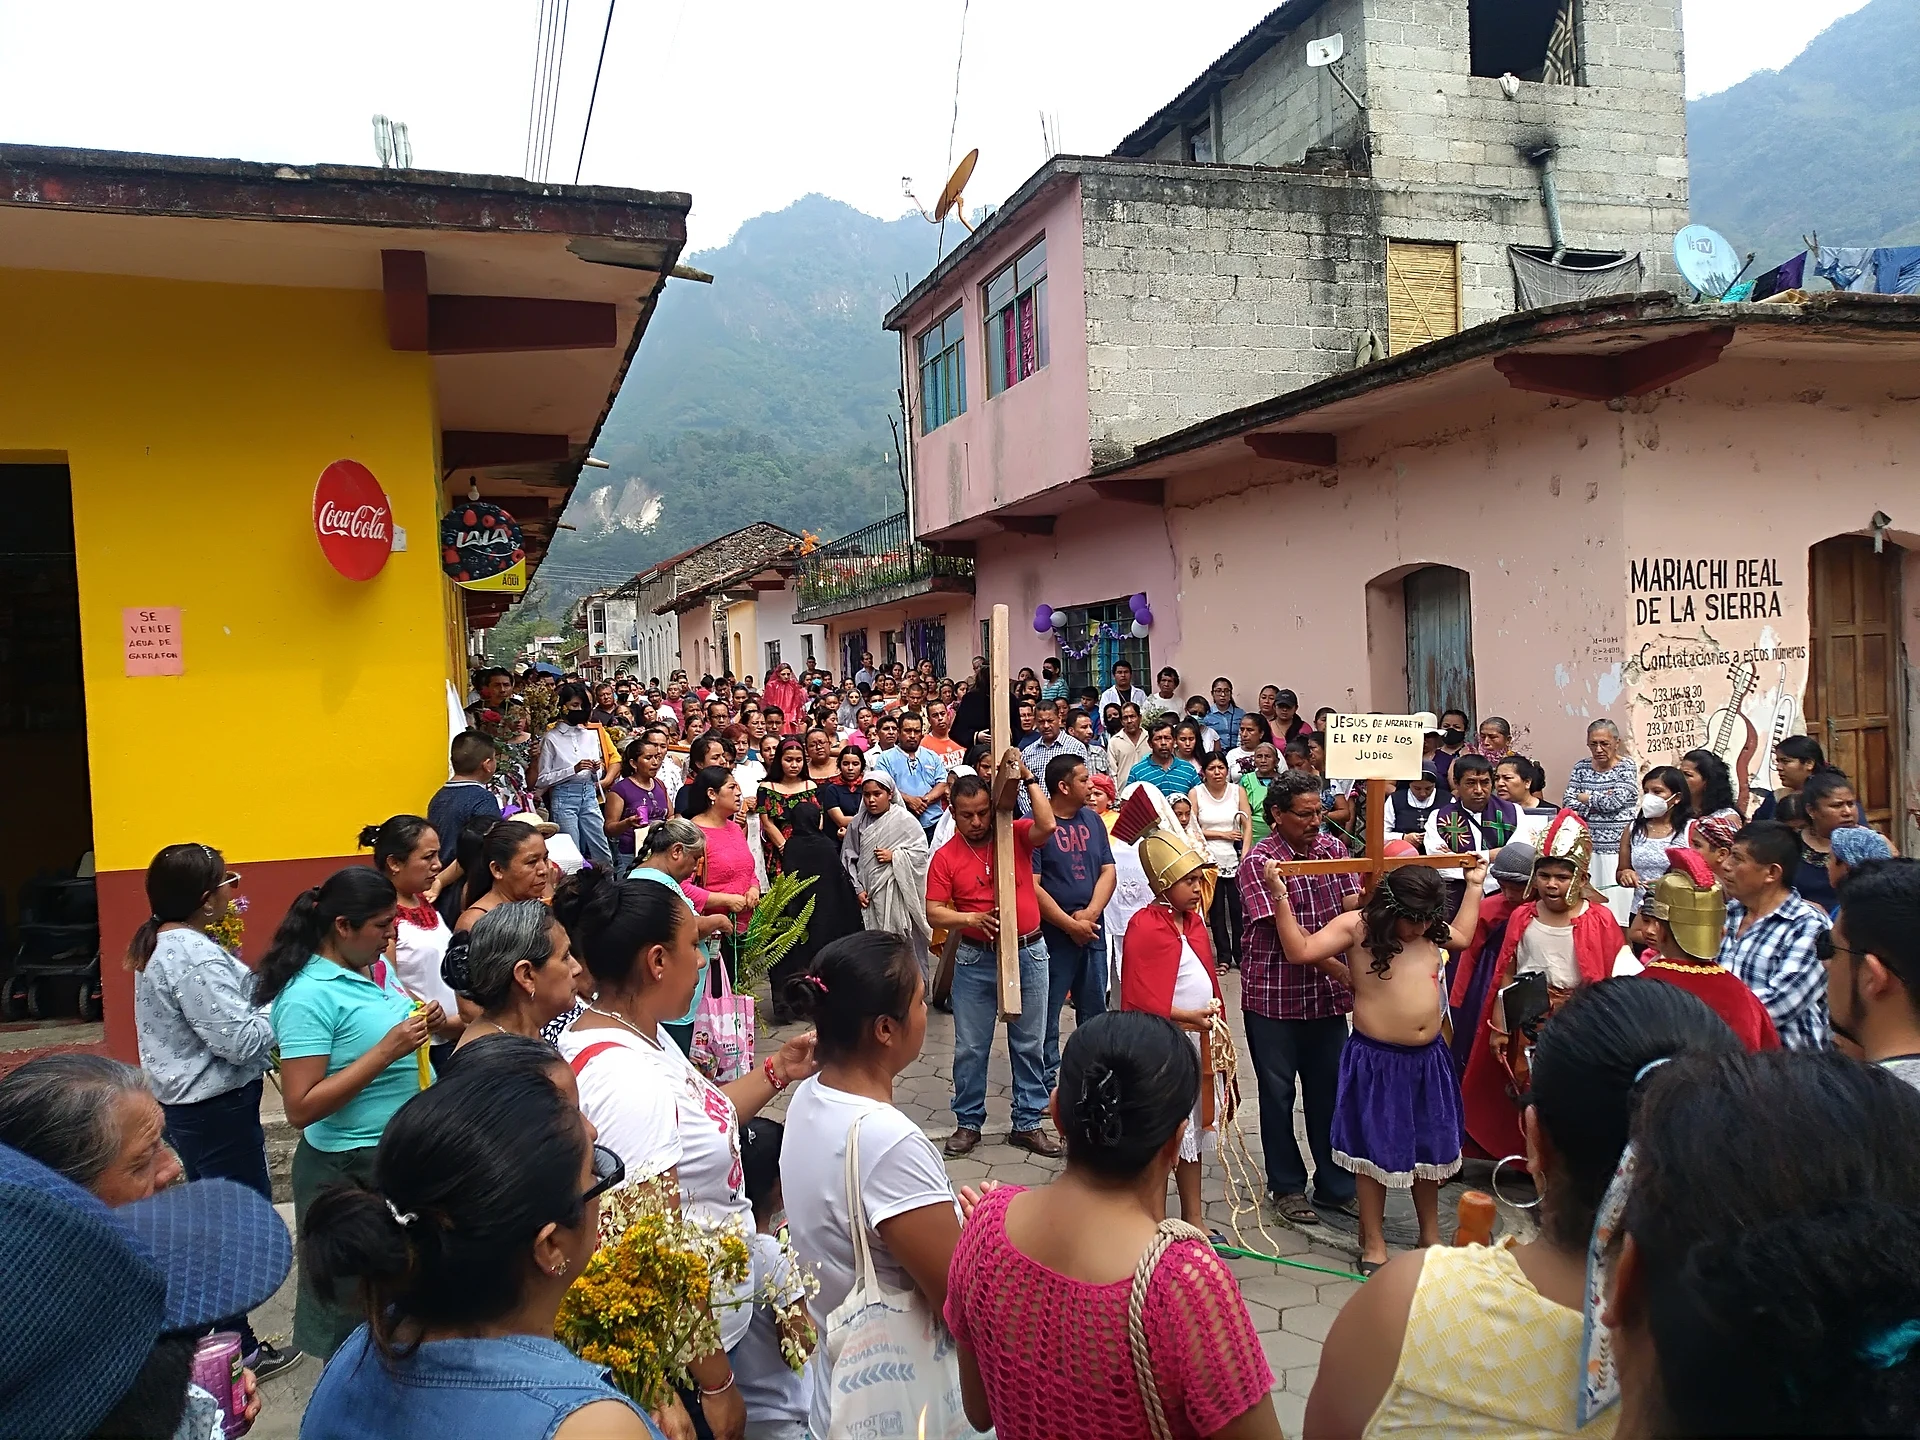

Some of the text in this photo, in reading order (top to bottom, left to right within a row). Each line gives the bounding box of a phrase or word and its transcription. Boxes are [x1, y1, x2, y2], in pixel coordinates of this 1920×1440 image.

[319, 500, 386, 540] Coca-Cola
[456, 528, 508, 548] LALA
[1736, 558, 1783, 588] REAL
[140, 611, 157, 622] SE
[1636, 591, 1782, 625] DE LA SIERRA
[130, 624, 171, 634] VENDE
[128, 652, 178, 660] GARRAFON
[1640, 642, 1730, 671] Contrataciones
[1733, 650, 1740, 663] a
[1743, 643, 1769, 662] estos
[1330, 715, 1423, 729] JESUS DE NAZARETH
[1333, 734, 1413, 745] EL REY DE LOS
[1054, 824, 1090, 853] GAP
